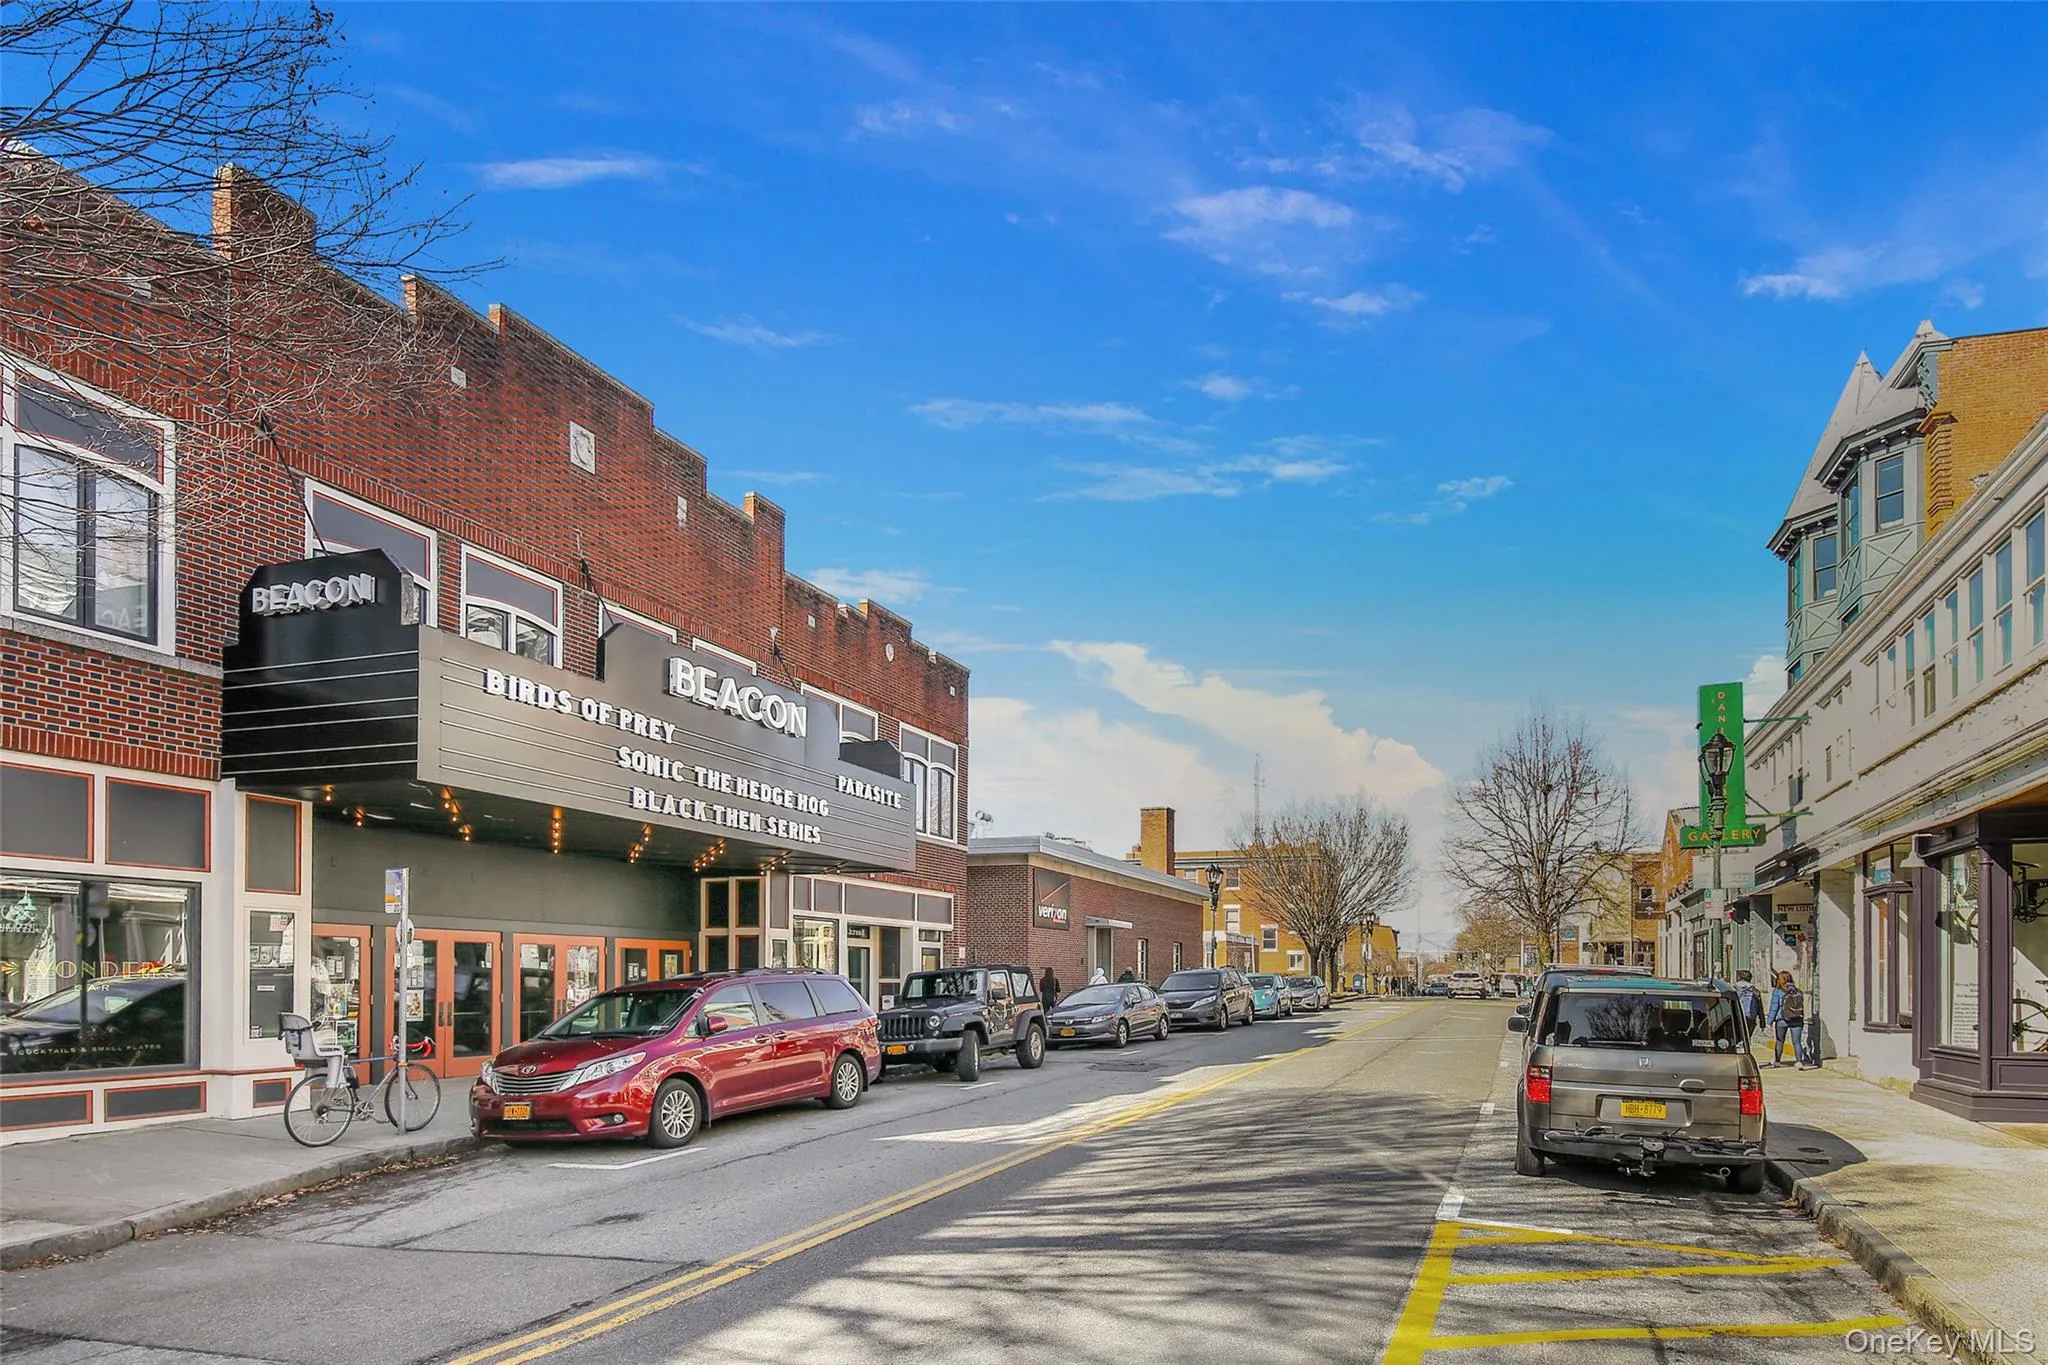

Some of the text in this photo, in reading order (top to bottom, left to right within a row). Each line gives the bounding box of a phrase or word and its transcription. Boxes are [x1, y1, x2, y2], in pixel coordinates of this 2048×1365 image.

[252, 573, 376, 616] BEACON
[486, 668, 676, 744] BIRDS OF PREY
[669, 657, 807, 738] BEACON
[617, 746, 684, 782] SONIC
[694, 766, 732, 795] THE
[838, 775, 902, 808] PARASITE
[632, 786, 821, 844] BLACK THEN SERIES
[1688, 828, 1760, 842] GALERY
[1038, 903, 1067, 923] verizon
[74, 984, 110, 992] BAR
